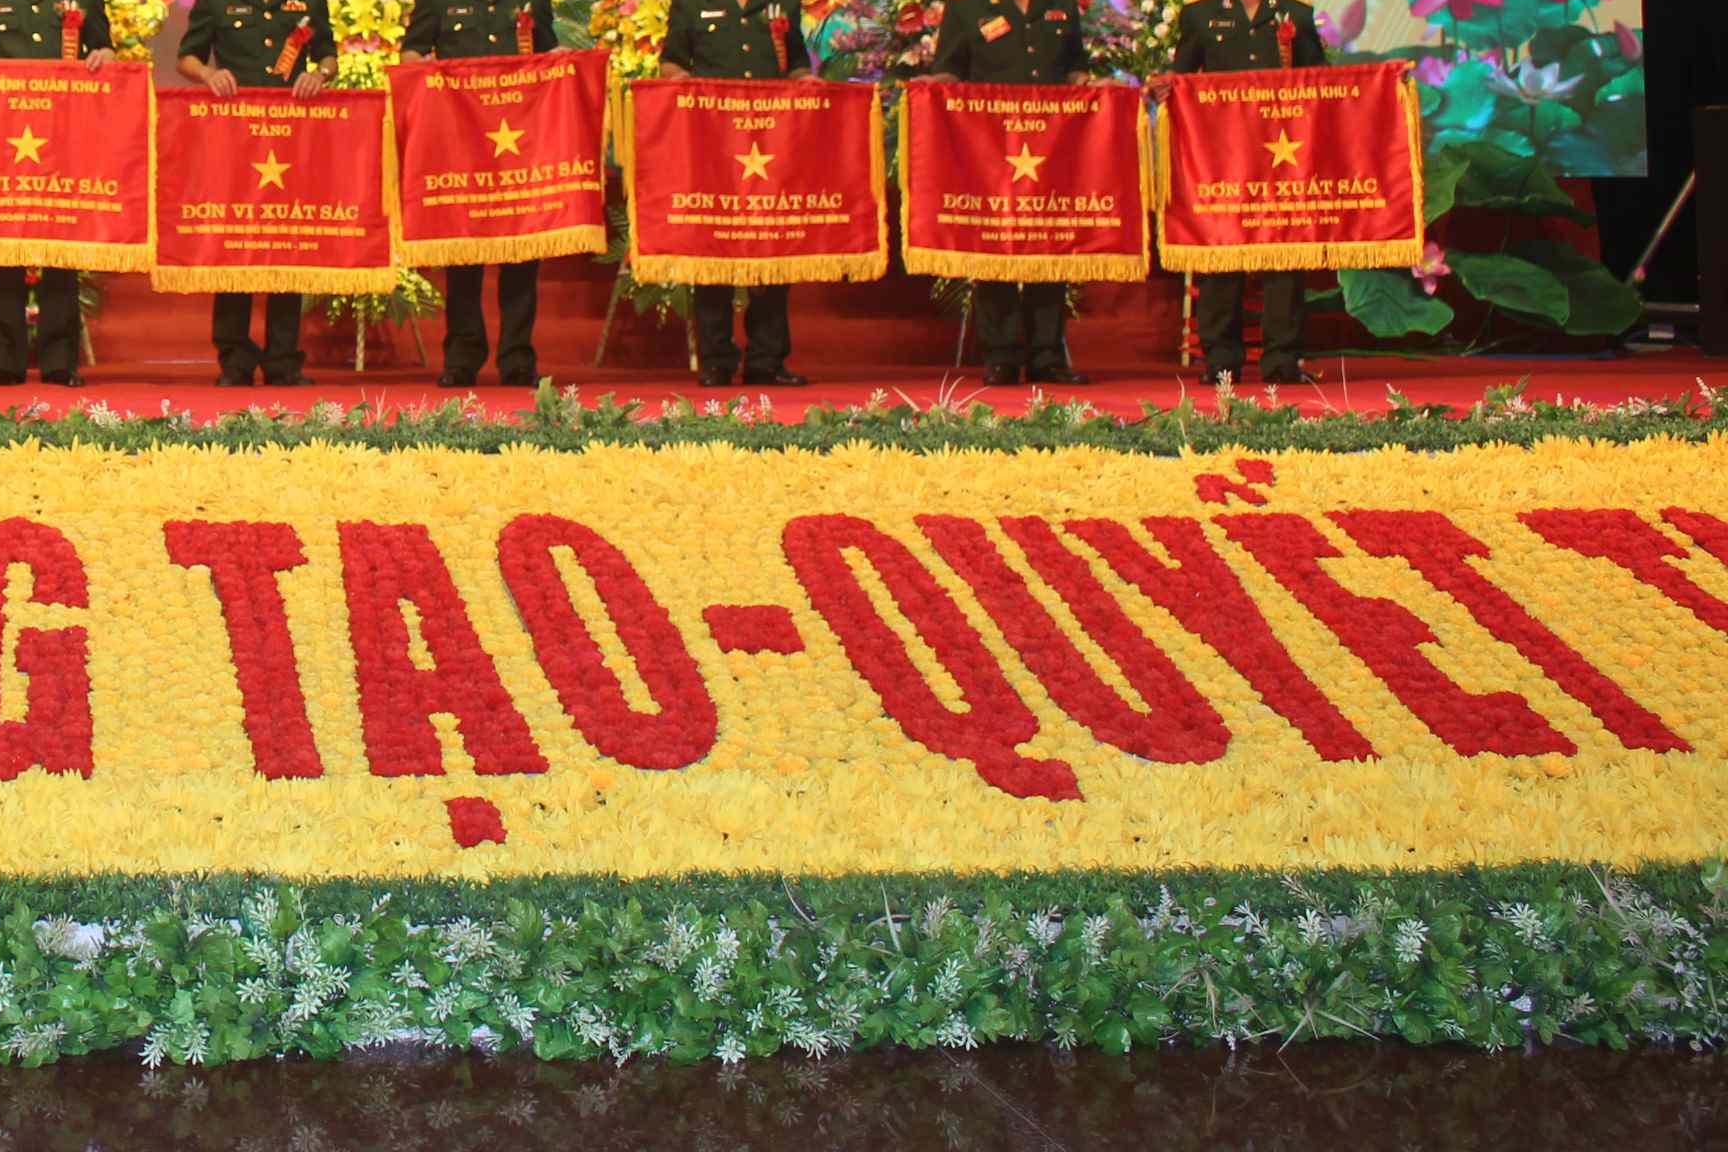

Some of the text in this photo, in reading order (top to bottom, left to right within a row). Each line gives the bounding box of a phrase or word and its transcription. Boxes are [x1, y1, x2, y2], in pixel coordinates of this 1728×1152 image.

[29, 77, 68, 92] QUÂN
[72, 79, 99, 93] KHU
[1221, 86, 1238, 102] TƯ
[1242, 87, 1275, 102] LỆNH
[1278, 86, 1317, 101] QUÂN
[1321, 86, 1347, 99] KHU
[1350, 86, 1360, 98] 4
[212, 103, 231, 117] TƯ
[232, 102, 265, 119] LỆNH
[268, 103, 306, 119] QUÂN
[310, 106, 336, 119] KHU
[754, 97, 791, 111] QUÂN
[795, 96, 819, 110] KHU
[968, 99, 985, 112] TƯ
[1023, 100, 1059, 114] QUÂN
[1064, 99, 1089, 113] KHU
[425, 172, 468, 191] ĐƠN
[500, 163, 555, 187] XUẤT
[559, 155, 595, 177] SẮC
[16, 173, 75, 194] XUẤT
[79, 177, 119, 196] SẮC
[1197, 181, 1240, 198] ĐƠN
[1275, 175, 1335, 197] XUẤT
[1337, 171, 1378, 195] SẮC
[182, 201, 226, 220] ĐƠN
[260, 199, 316, 220] XUẤT
[320, 200, 359, 221] SẮC
[672, 192, 715, 209] ĐƠN
[745, 190, 802, 211] XUẤT
[806, 191, 843, 210] SẮC
[943, 193, 986, 211] ĐƠN
[1016, 190, 1071, 212] XUẤT
[1075, 191, 1114, 212] SẮC
[164, 512, 719, 848] TẠO
[782, 458, 1695, 801] QUYẾT
